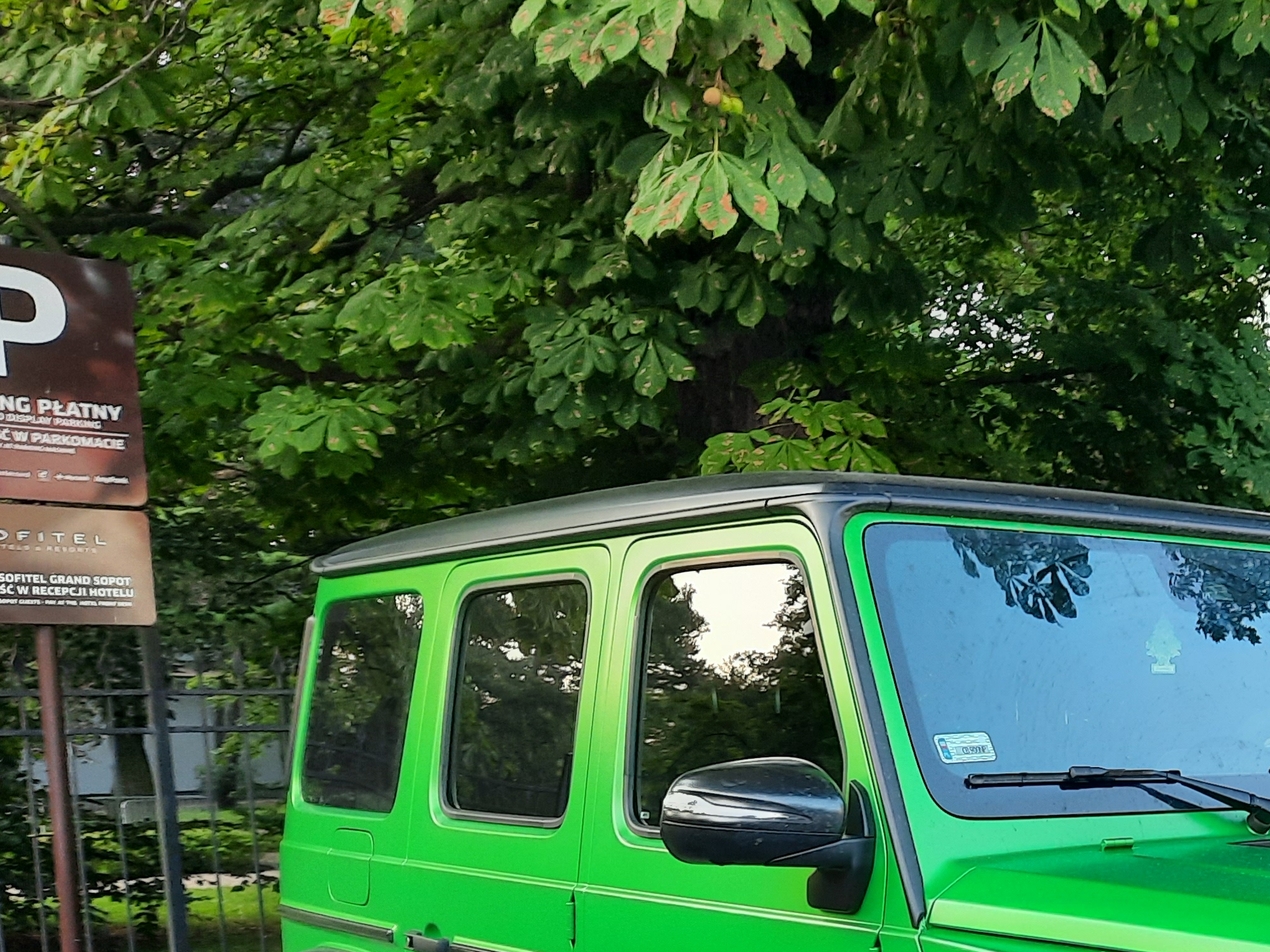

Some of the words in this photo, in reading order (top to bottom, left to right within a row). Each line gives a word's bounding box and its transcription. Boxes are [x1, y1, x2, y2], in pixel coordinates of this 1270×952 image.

[0, 263, 68, 378] P
[36, 398, 122, 421] PŁATNY
[11, 431, 29, 442] W
[30, 432, 126, 450] PARKOMACIE
[49, 574, 91, 585] GRAND
[92, 576, 132, 587] SOPOT
[17, 585, 29, 595] W
[32, 586, 88, 597] RECEPCJI
[89, 588, 134, 598] HOTELU
